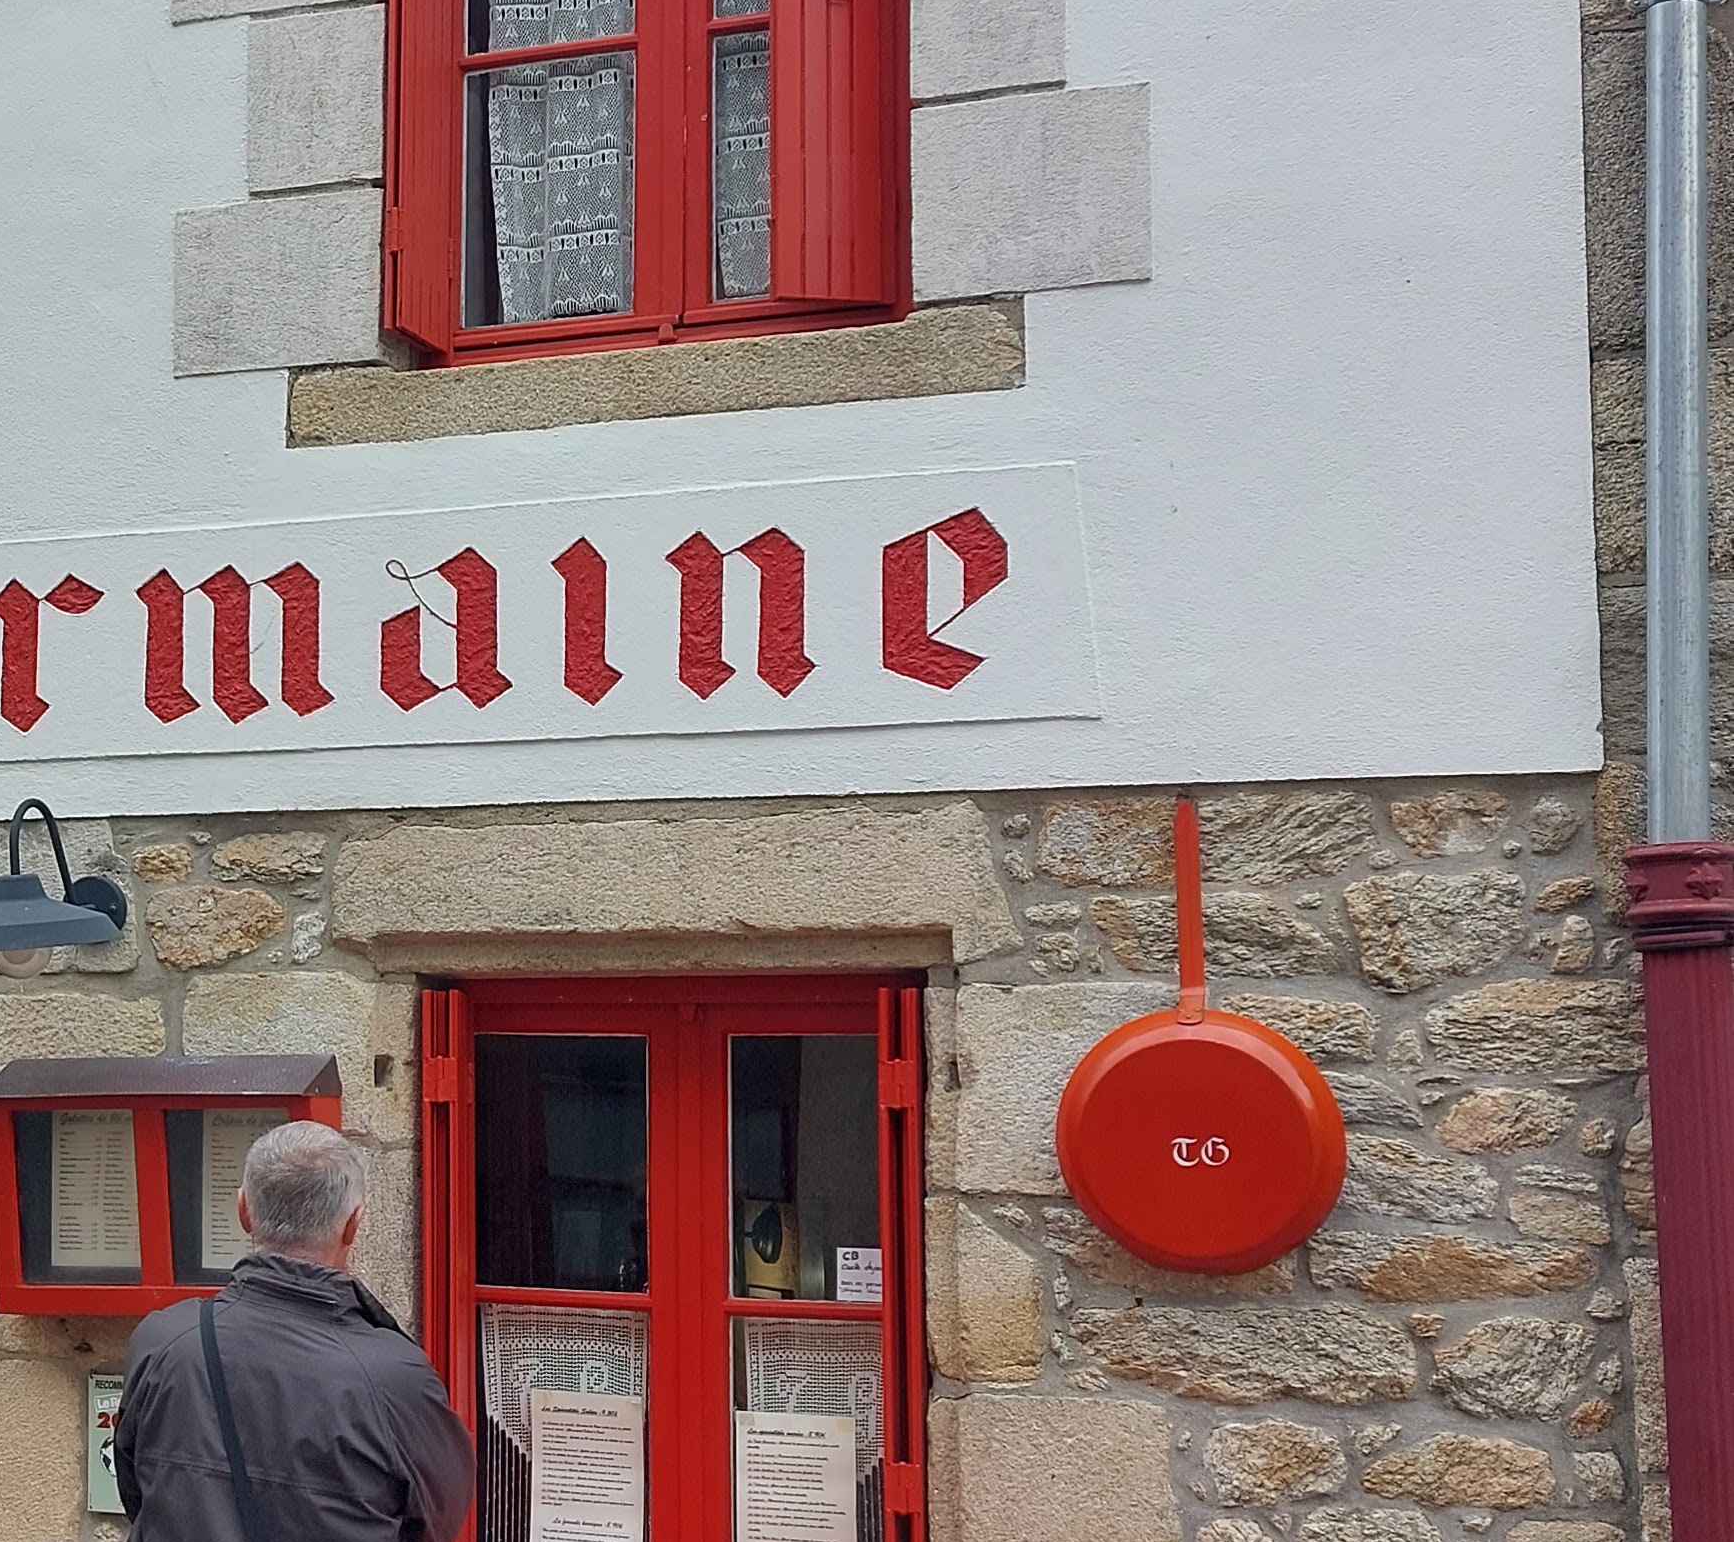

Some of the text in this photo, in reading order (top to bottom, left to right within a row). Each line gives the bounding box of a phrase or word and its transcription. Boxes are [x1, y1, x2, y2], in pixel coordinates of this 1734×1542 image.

[1171, 1137, 1230, 1166] TG
[842, 1251, 859, 1261] CB
[95, 1379, 123, 1389] RECOMM
[97, 1411, 121, 1428] 20
